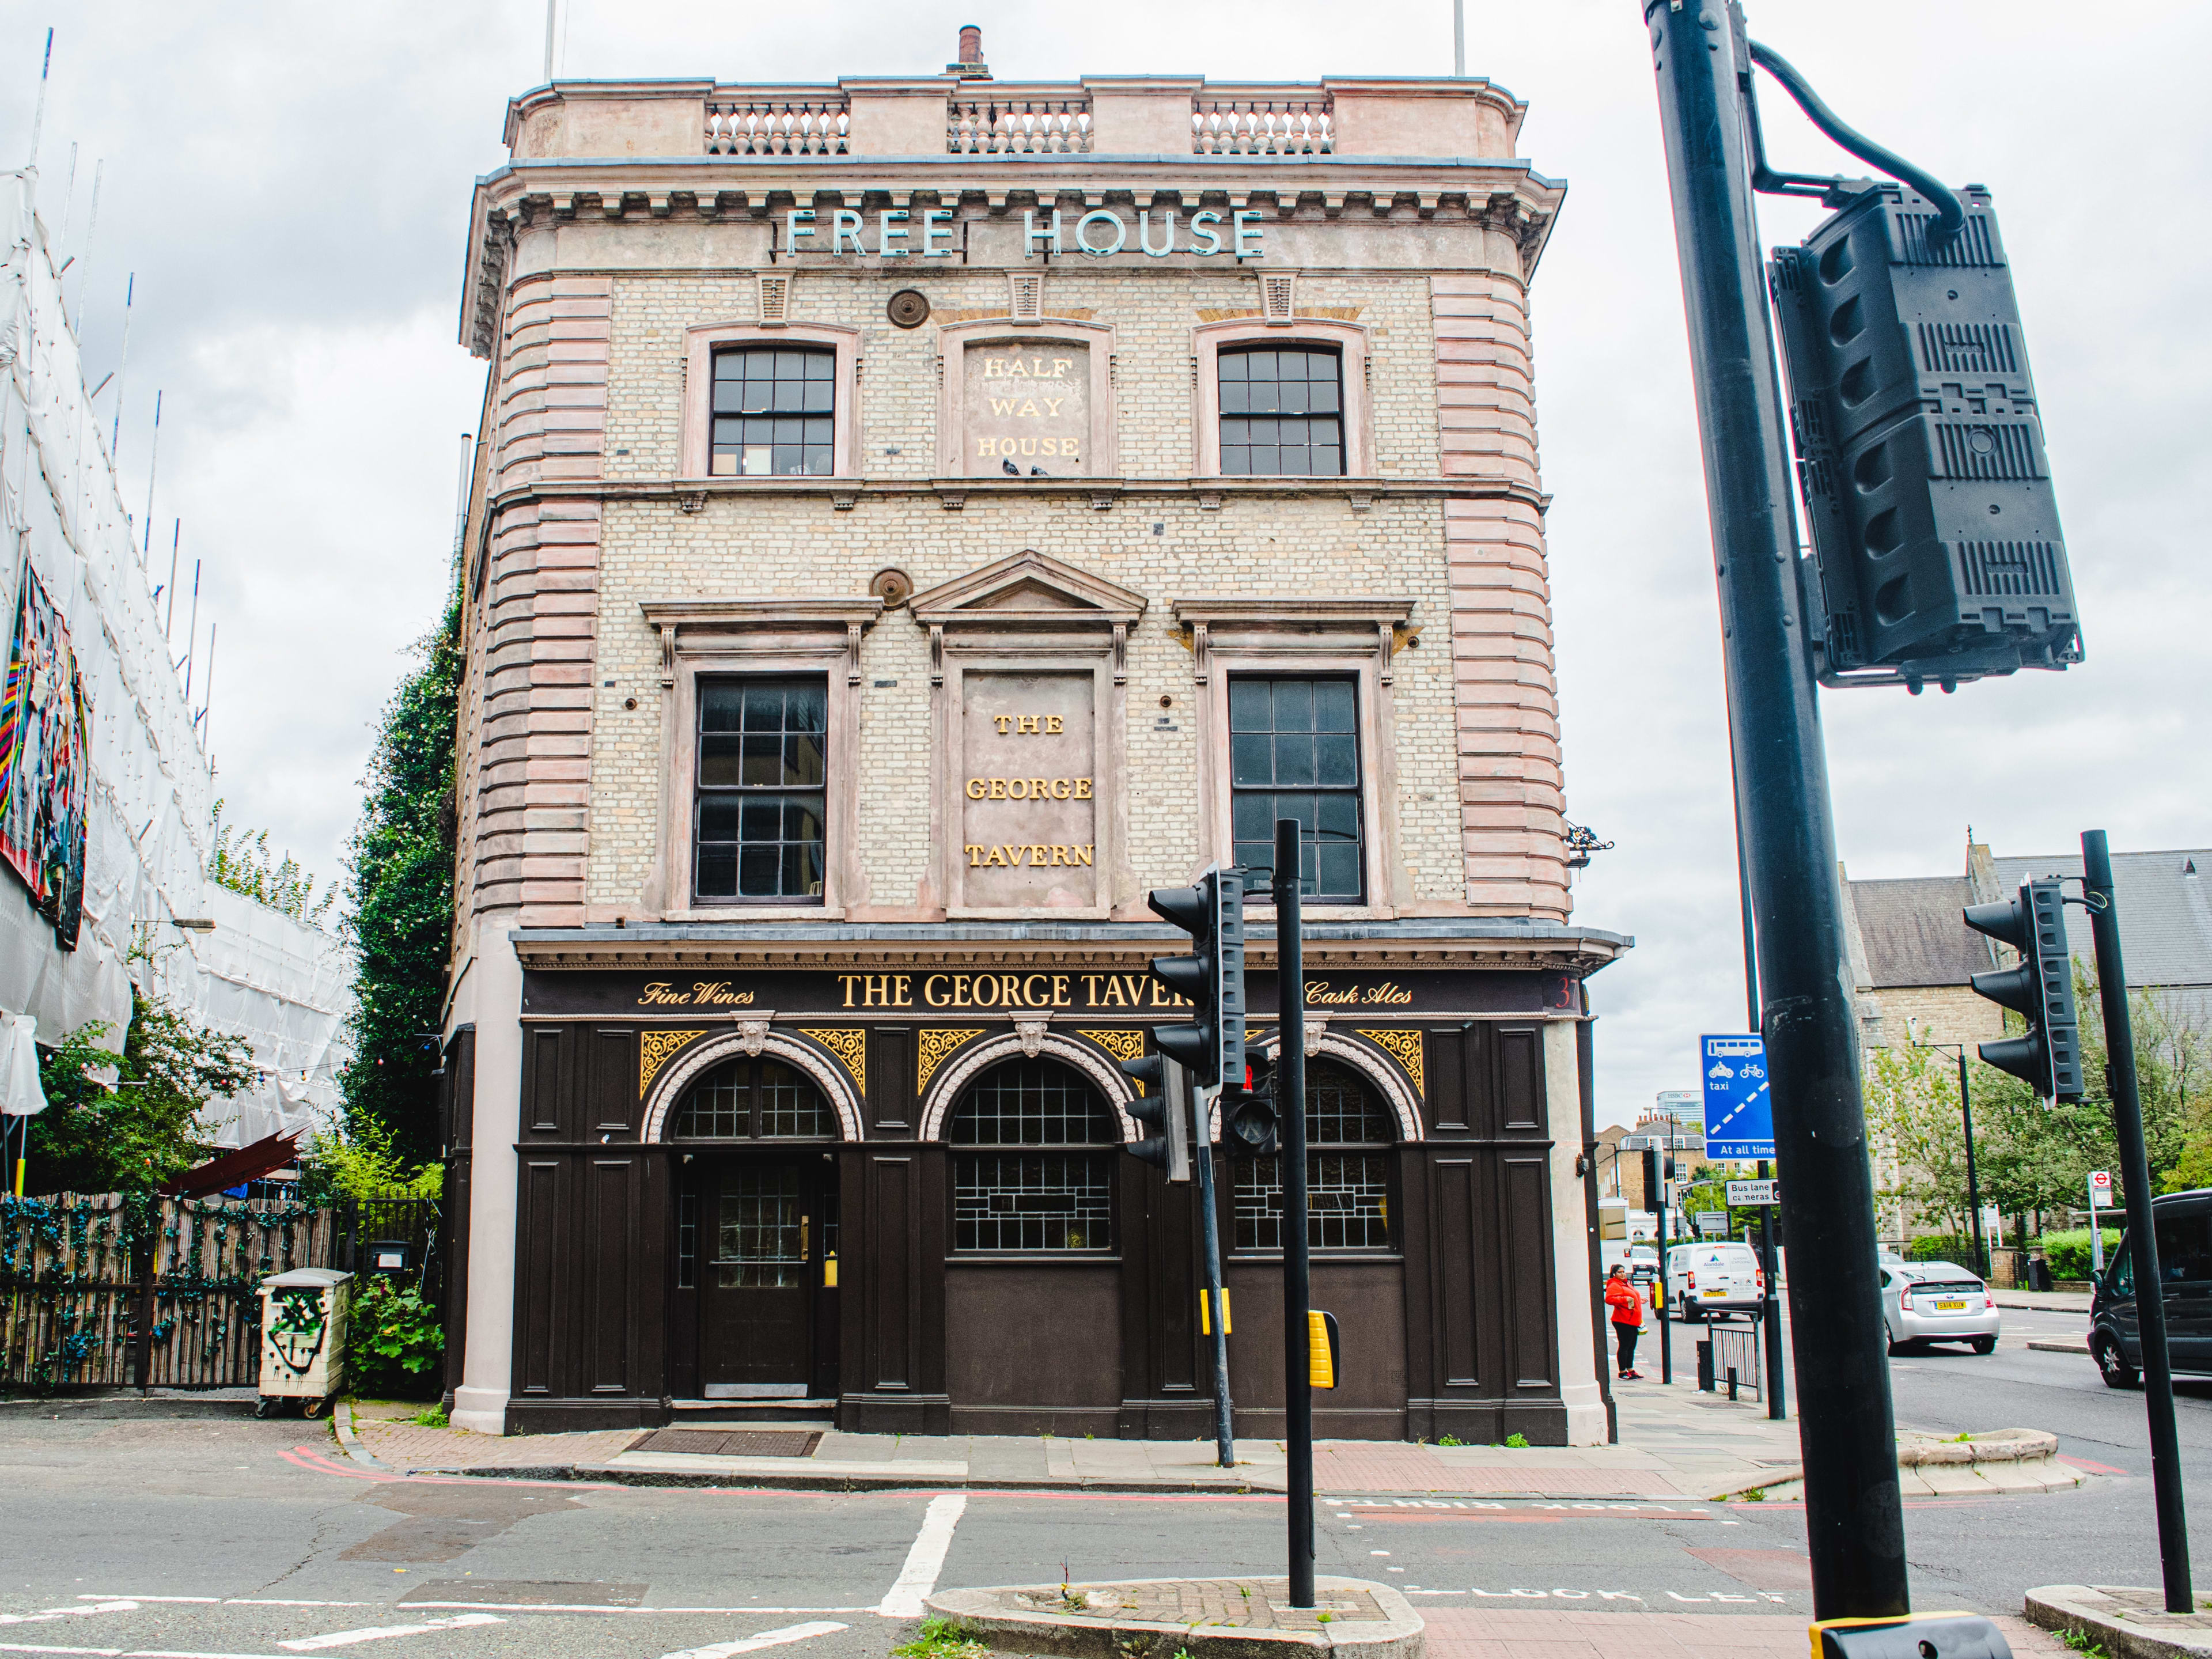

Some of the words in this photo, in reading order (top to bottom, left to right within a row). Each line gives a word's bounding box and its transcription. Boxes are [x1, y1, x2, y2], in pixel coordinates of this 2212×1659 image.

[786, 209, 953, 257] FREE
[1024, 209, 1264, 258] HOUSE
[984, 358, 1073, 378] HALF
[988, 397, 1064, 417] WAY
[977, 437, 1080, 457] HOUSE
[994, 715, 1063, 734] THE
[966, 778, 1092, 800] GEORGE
[964, 844, 1094, 866] TAVERN
[637, 982, 690, 1006] Fine
[692, 982, 755, 1005] Wines
[838, 974, 912, 1007] THE
[924, 974, 1071, 1007] GEORGE
[1081, 974, 1195, 1007] TAVE
[1304, 980, 1359, 1005] Cask
[1361, 981, 1412, 1005] Ales
[1709, 1081, 1729, 1090] taxi
[1721, 1145, 1733, 1154] At
[1736, 1145, 1749, 1154] all
[1752, 1145, 1775, 1154] time
[1472, 1588, 1642, 1601] LOOK
